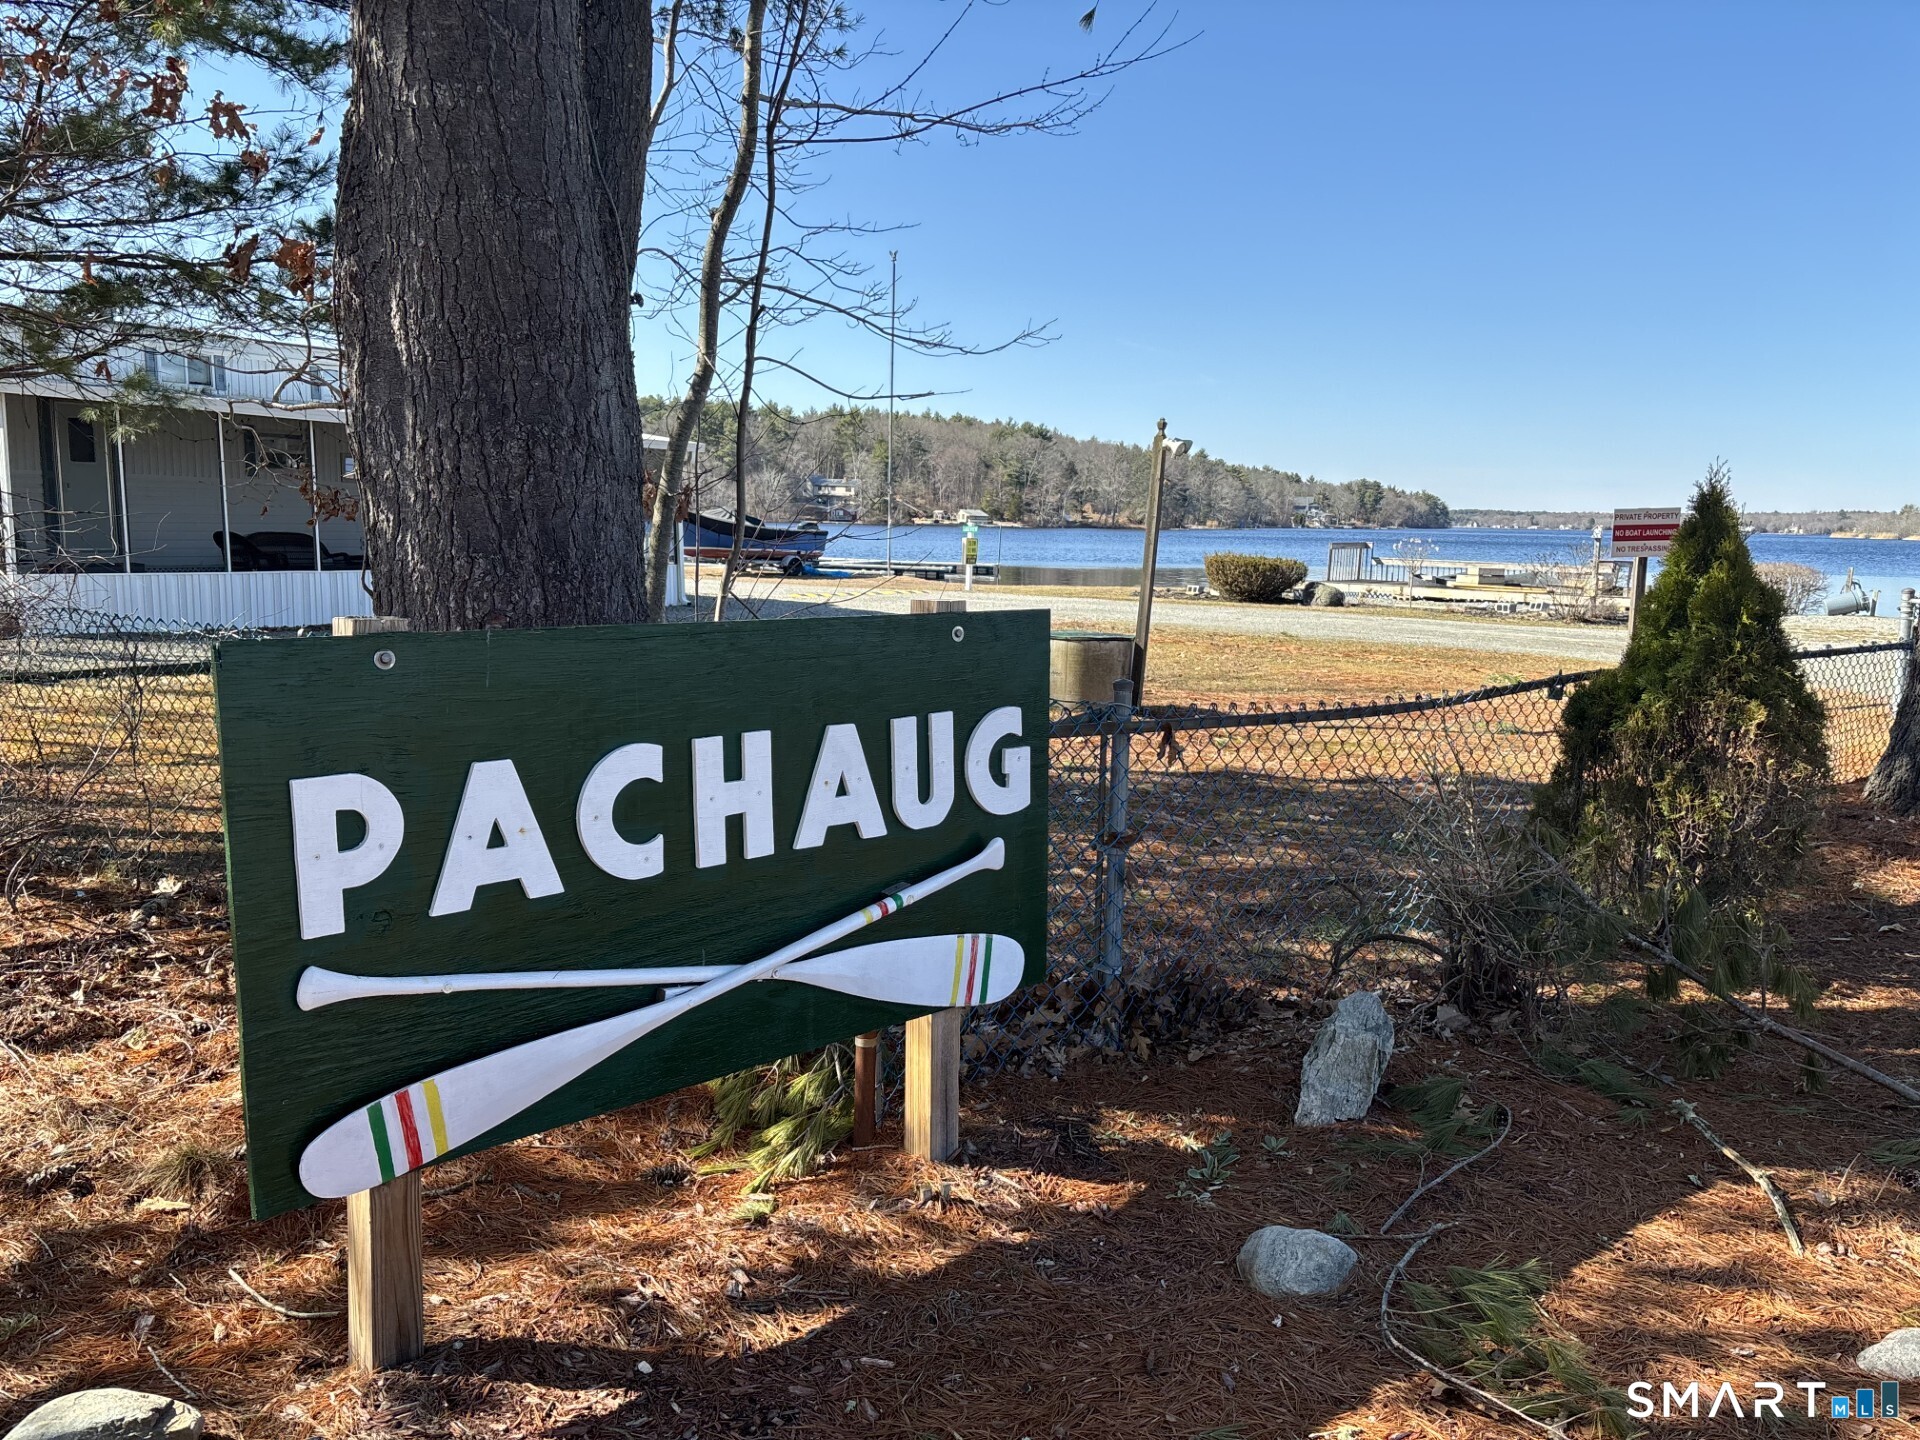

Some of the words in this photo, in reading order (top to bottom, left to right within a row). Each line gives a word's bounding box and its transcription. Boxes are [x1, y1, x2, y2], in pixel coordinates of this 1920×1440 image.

[1614, 513, 1642, 521] PRIVATE
[1644, 512, 1679, 520] PROPERTY
[1615, 529, 1625, 537] NO
[1625, 529, 1641, 537] BOAT
[1616, 545, 1626, 553] NO
[1628, 544, 1671, 553] TRESPASSIN
[289, 706, 1033, 940] PACHAUG
